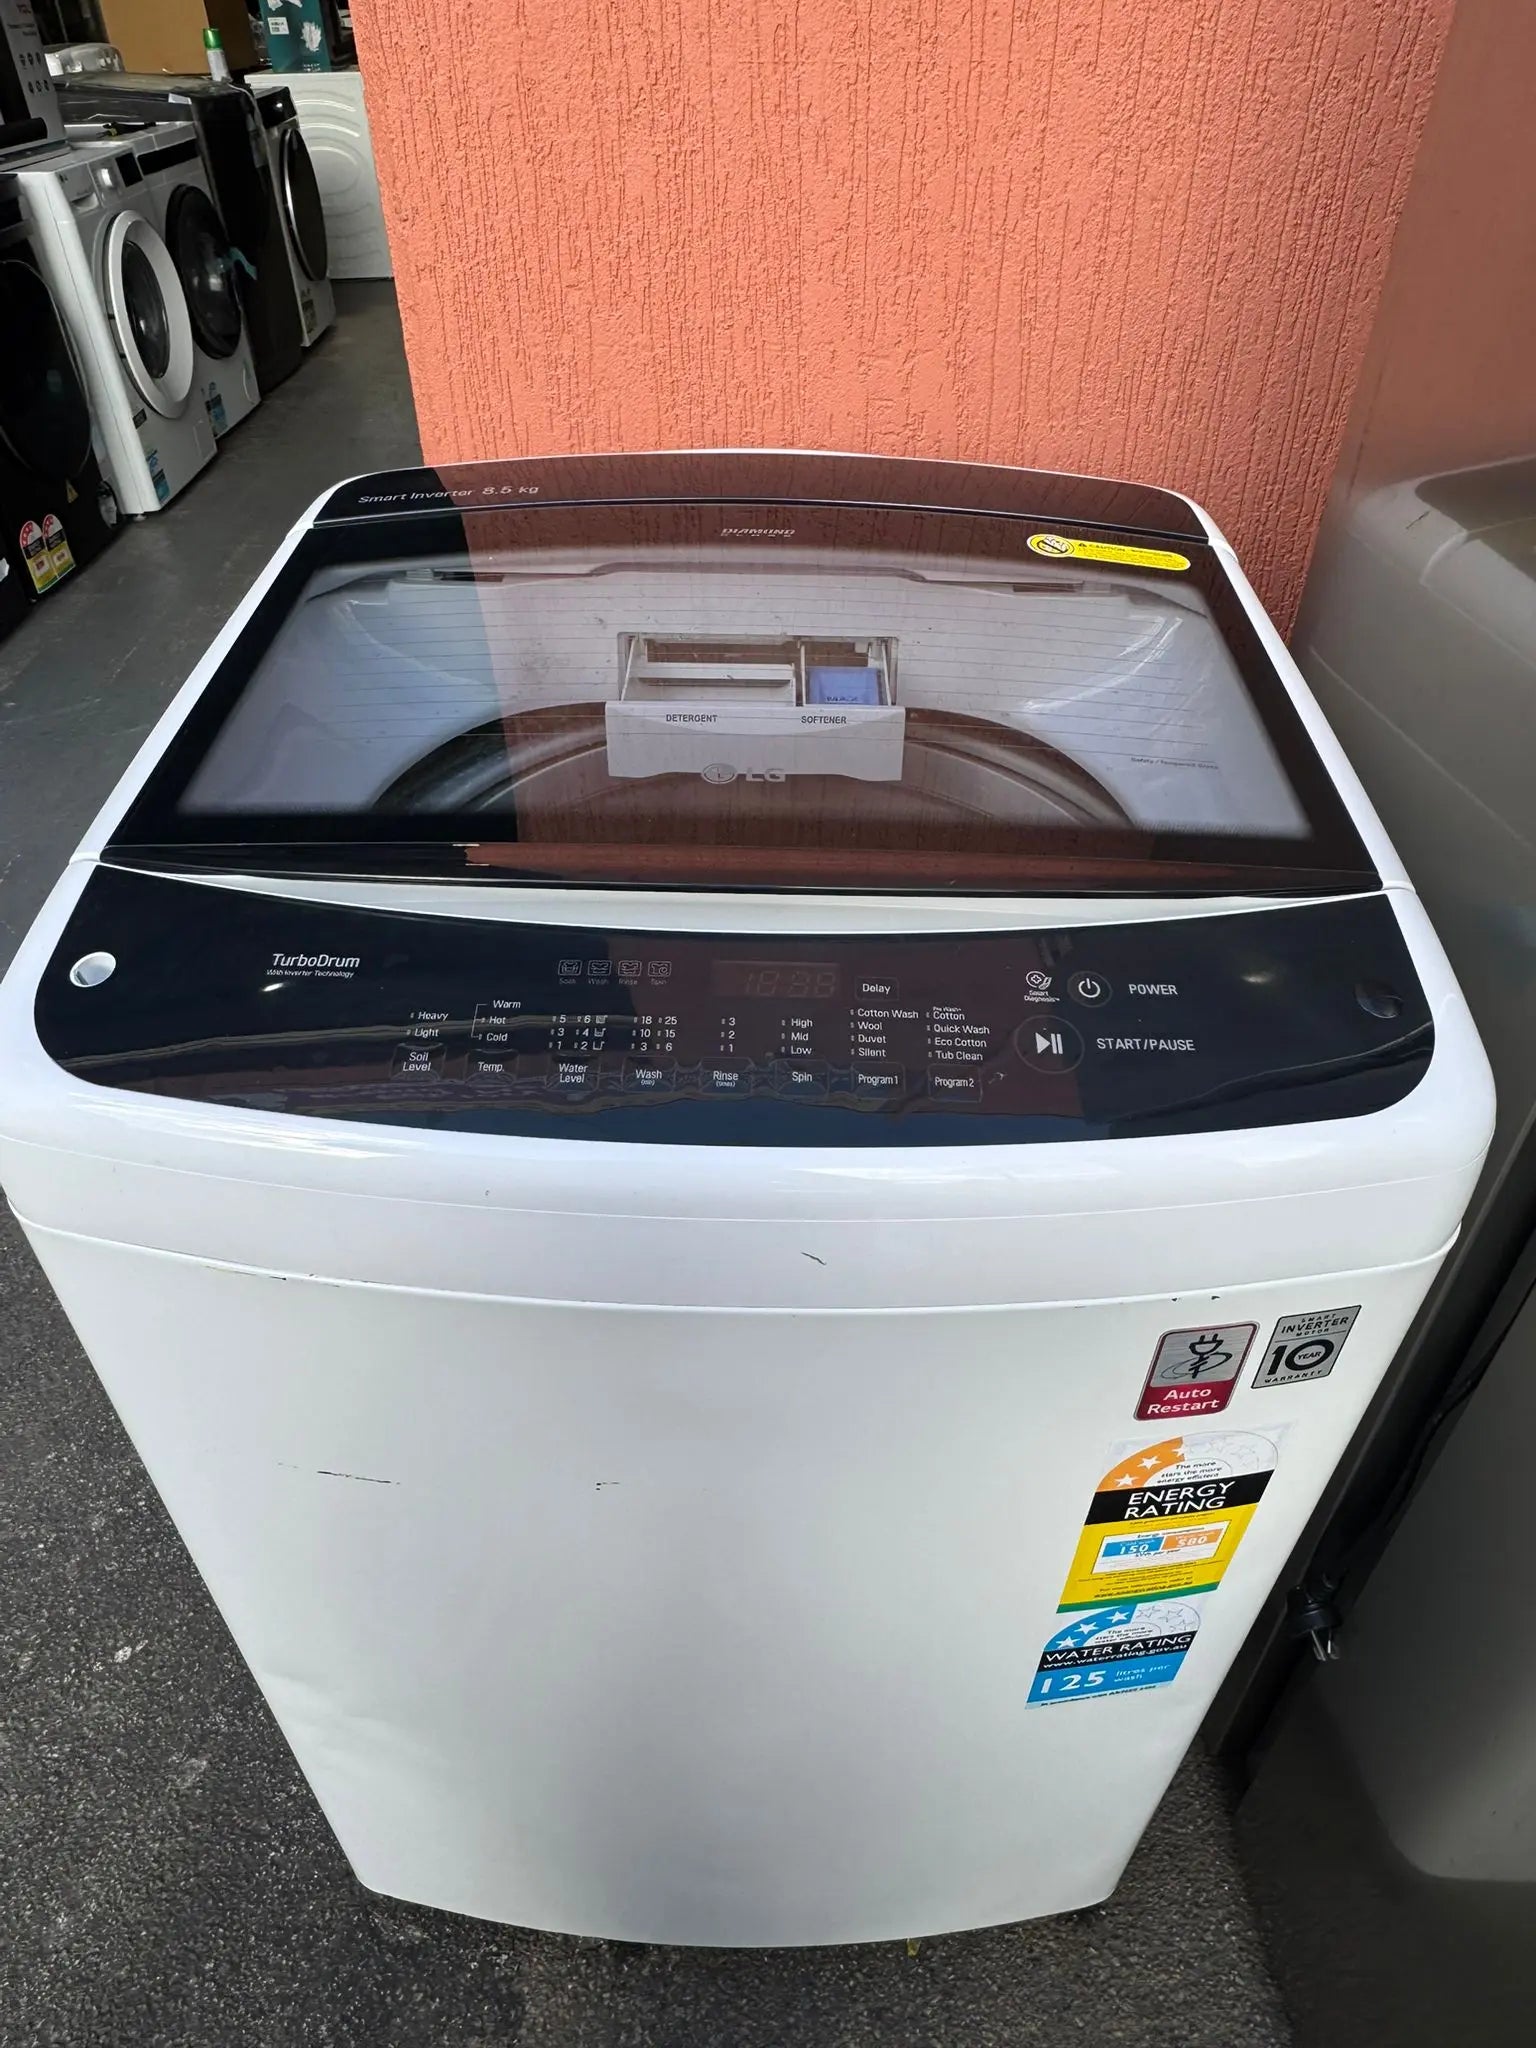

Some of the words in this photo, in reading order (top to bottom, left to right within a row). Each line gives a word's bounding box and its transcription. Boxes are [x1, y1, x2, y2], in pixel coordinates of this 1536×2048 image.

[358, 494, 406, 504] Smart
[410, 489, 474, 500] Inverter
[482, 486, 512, 496] 8.5
[519, 486, 540, 495] kg
[665, 714, 718, 724] DETERGENT
[800, 715, 848, 726] SOFTENER
[745, 768, 786, 784] LG
[272, 953, 360, 968] TurboDrum
[314, 970, 355, 978] Technology
[862, 984, 891, 995] Delay
[1128, 984, 1178, 996] POWER
[493, 1000, 521, 1009] Warm
[418, 1012, 449, 1022] Heavy
[858, 1008, 890, 1019] Cotton
[892, 1010, 920, 1020] Wash
[933, 1012, 966, 1022] Cotton
[489, 1016, 506, 1025] Hot
[560, 1015, 567, 1024] 5
[584, 1015, 591, 1024] 6
[641, 1016, 653, 1025] 18
[664, 1016, 678, 1026] 25
[728, 1018, 736, 1026] 3
[791, 1018, 814, 1029] High
[858, 1022, 883, 1032] Wool
[934, 1024, 962, 1036] Quick
[962, 1025, 990, 1036] Wash
[414, 1028, 440, 1038] Light
[486, 1033, 508, 1042] Cold
[557, 1028, 565, 1037] 3
[582, 1028, 590, 1037] 4
[640, 1029, 652, 1038] 10
[665, 1030, 676, 1039] 15
[728, 1030, 736, 1040] 2
[791, 1032, 809, 1042] Mid
[858, 1034, 887, 1044] Duvet
[935, 1038, 954, 1047] Eco
[955, 1038, 988, 1048] Cotton
[557, 1042, 562, 1050] 1
[580, 1042, 588, 1050] 2
[640, 1042, 648, 1052] 3
[666, 1042, 673, 1052] 6
[728, 1044, 734, 1052] 1
[790, 1045, 812, 1055] Low
[1096, 1038, 1196, 1052] START/PAUSE
[408, 1052, 429, 1062] Soil
[858, 1048, 887, 1058] Silent
[936, 1051, 954, 1060] Tub
[956, 1052, 984, 1062] Clean
[402, 1062, 432, 1072] Level
[478, 1062, 506, 1073] Temp.
[558, 1063, 588, 1074] Water
[560, 1074, 586, 1084] Level
[636, 1069, 663, 1080] Wash
[713, 1070, 739, 1082] Rinse
[792, 1072, 813, 1084] Spin
[1302, 1314, 1337, 1323] SMART
[1282, 1316, 1350, 1334] INVERTER
[1296, 1328, 1330, 1337] MOTOR
[1267, 1339, 1336, 1376] 10
[1298, 1351, 1322, 1360] YEAR
[1264, 1369, 1323, 1384] WARRANTY
[1164, 1388, 1212, 1402] Auto
[1147, 1399, 1220, 1415] Restart
[1128, 1481, 1236, 1506] ENERGY
[1124, 1496, 1226, 1520] RATING
[1120, 1544, 1150, 1555] 150
[1046, 1646, 1114, 1662] WATER
[1119, 1635, 1192, 1652] RATING
[1043, 1644, 1188, 1669] www.waterrating.gov.au
[1115, 1668, 1146, 1678] litres
[1040, 1670, 1106, 1694] 125
[1114, 1674, 1144, 1683] wash
